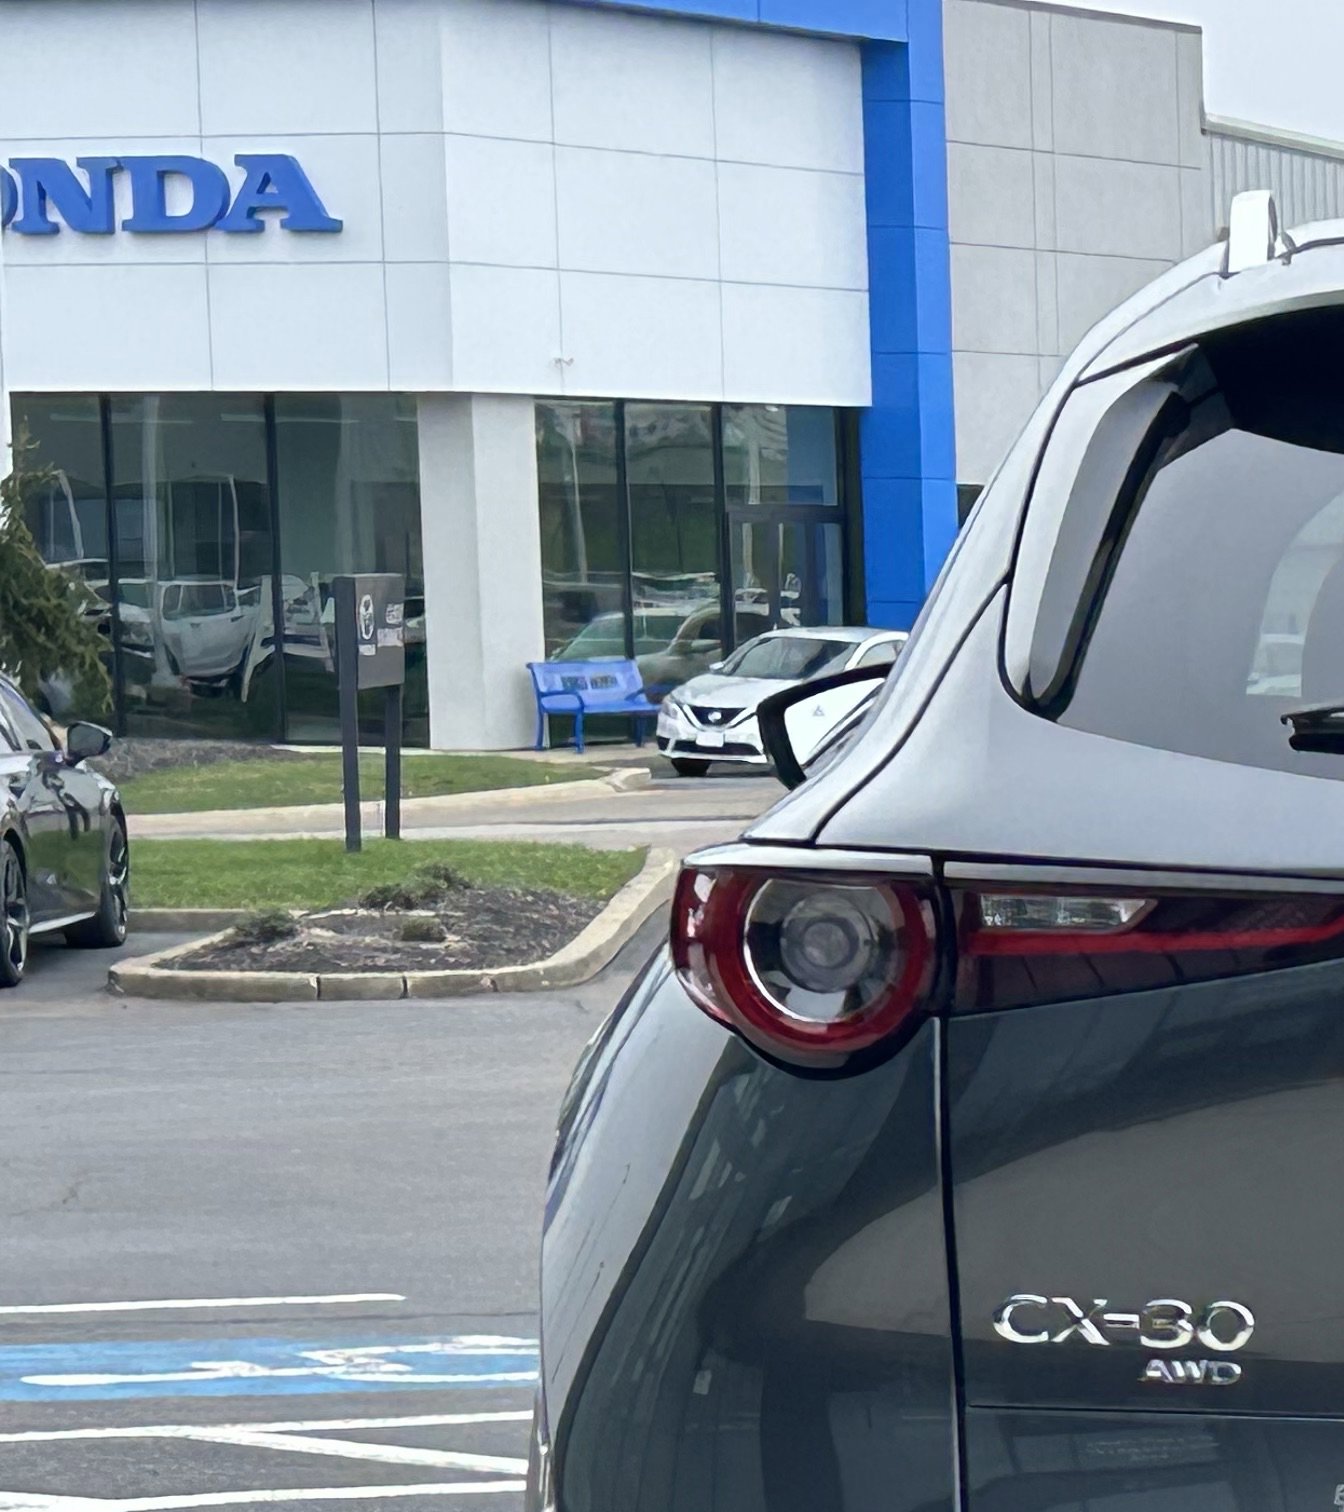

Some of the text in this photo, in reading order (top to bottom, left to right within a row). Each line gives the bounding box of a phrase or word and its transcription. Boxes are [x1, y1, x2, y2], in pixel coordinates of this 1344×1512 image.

[0, 153, 344, 235] NDA
[993, 1293, 1255, 1352] CX-30
[1139, 1358, 1243, 1386] AWD
